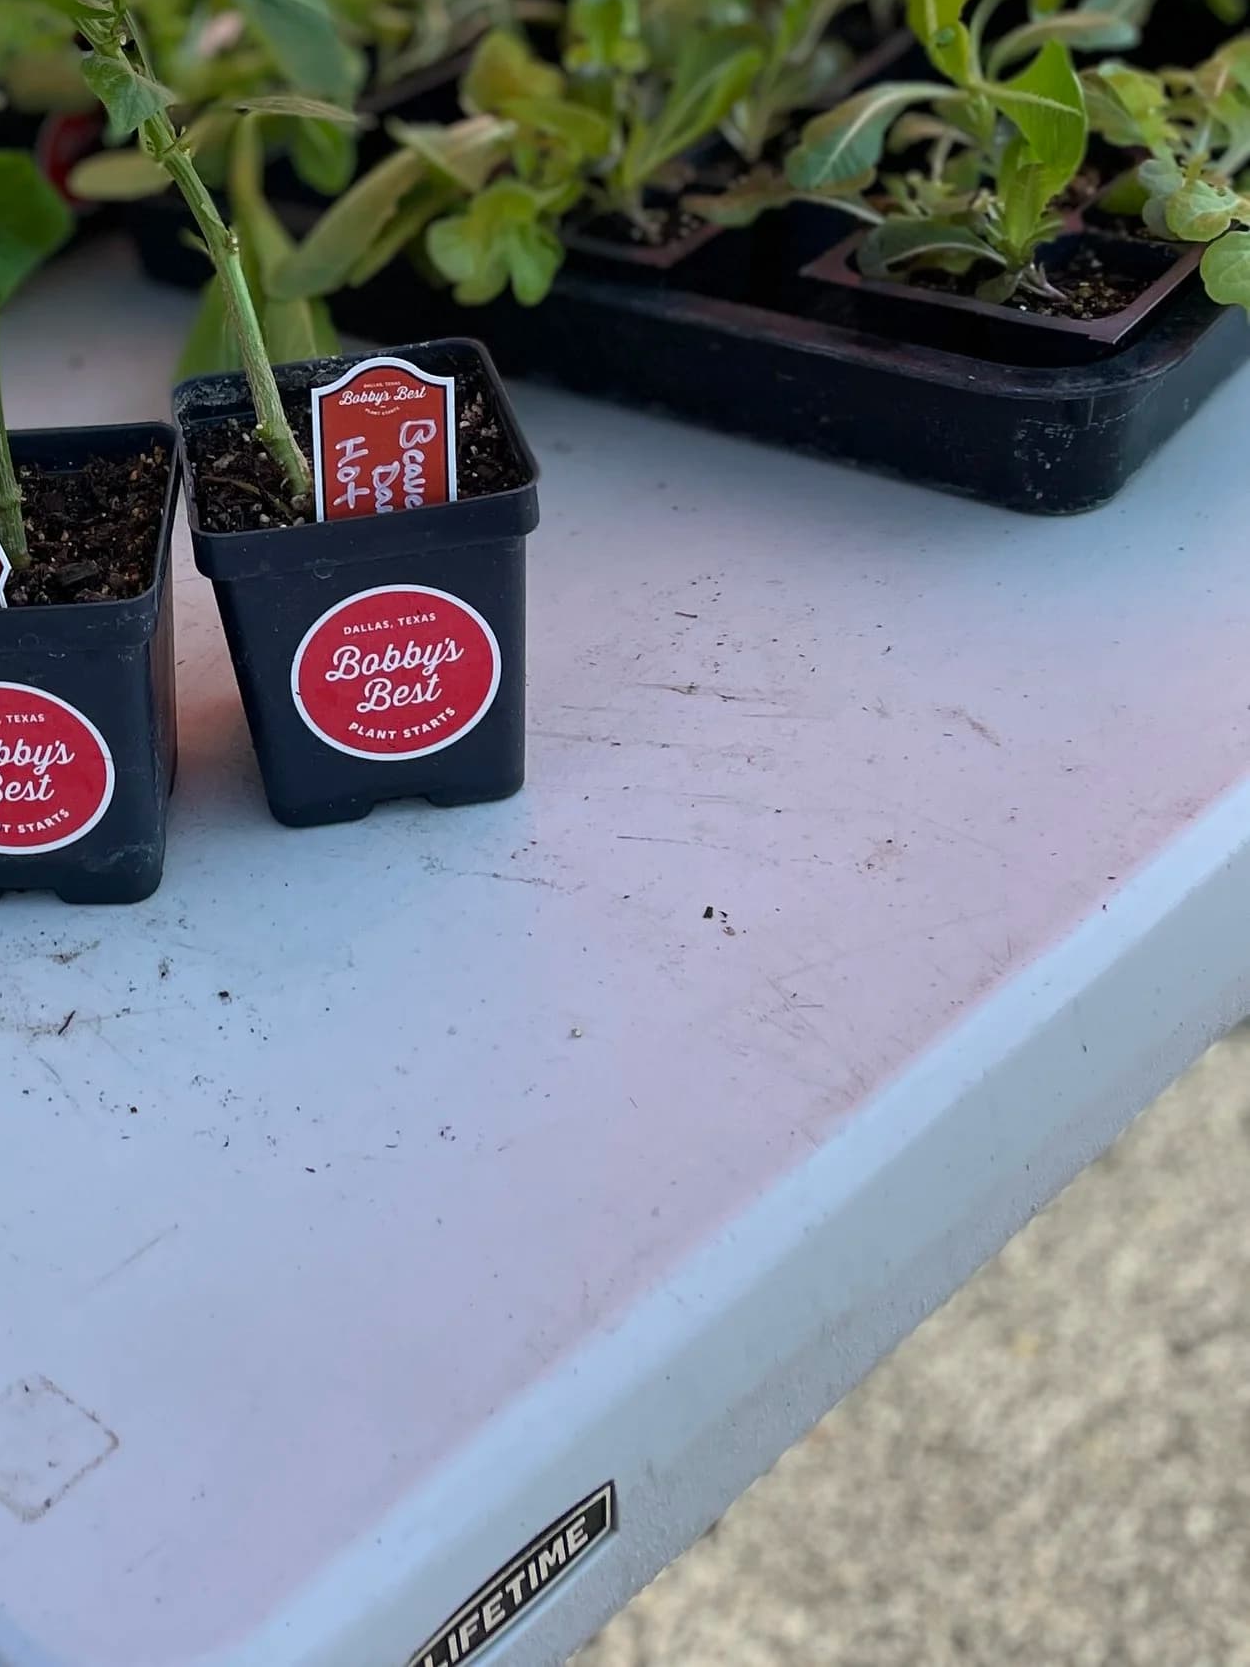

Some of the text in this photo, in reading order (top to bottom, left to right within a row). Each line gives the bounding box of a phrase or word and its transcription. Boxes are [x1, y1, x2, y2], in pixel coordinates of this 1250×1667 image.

[338, 385, 427, 406] Bobby's Best
[333, 436, 370, 510] Hot
[399, 419, 437, 509] Beave
[398, 612, 437, 627] TEXAS
[325, 637, 464, 682] Bobby's
[356, 673, 442, 713] Best
[6, 713, 45, 723] TEXAS
[348, 707, 456, 740] PLANT STARTS
[17, 808, 70, 834] STARTS
[424, 1515, 589, 1667] LIFETIME
